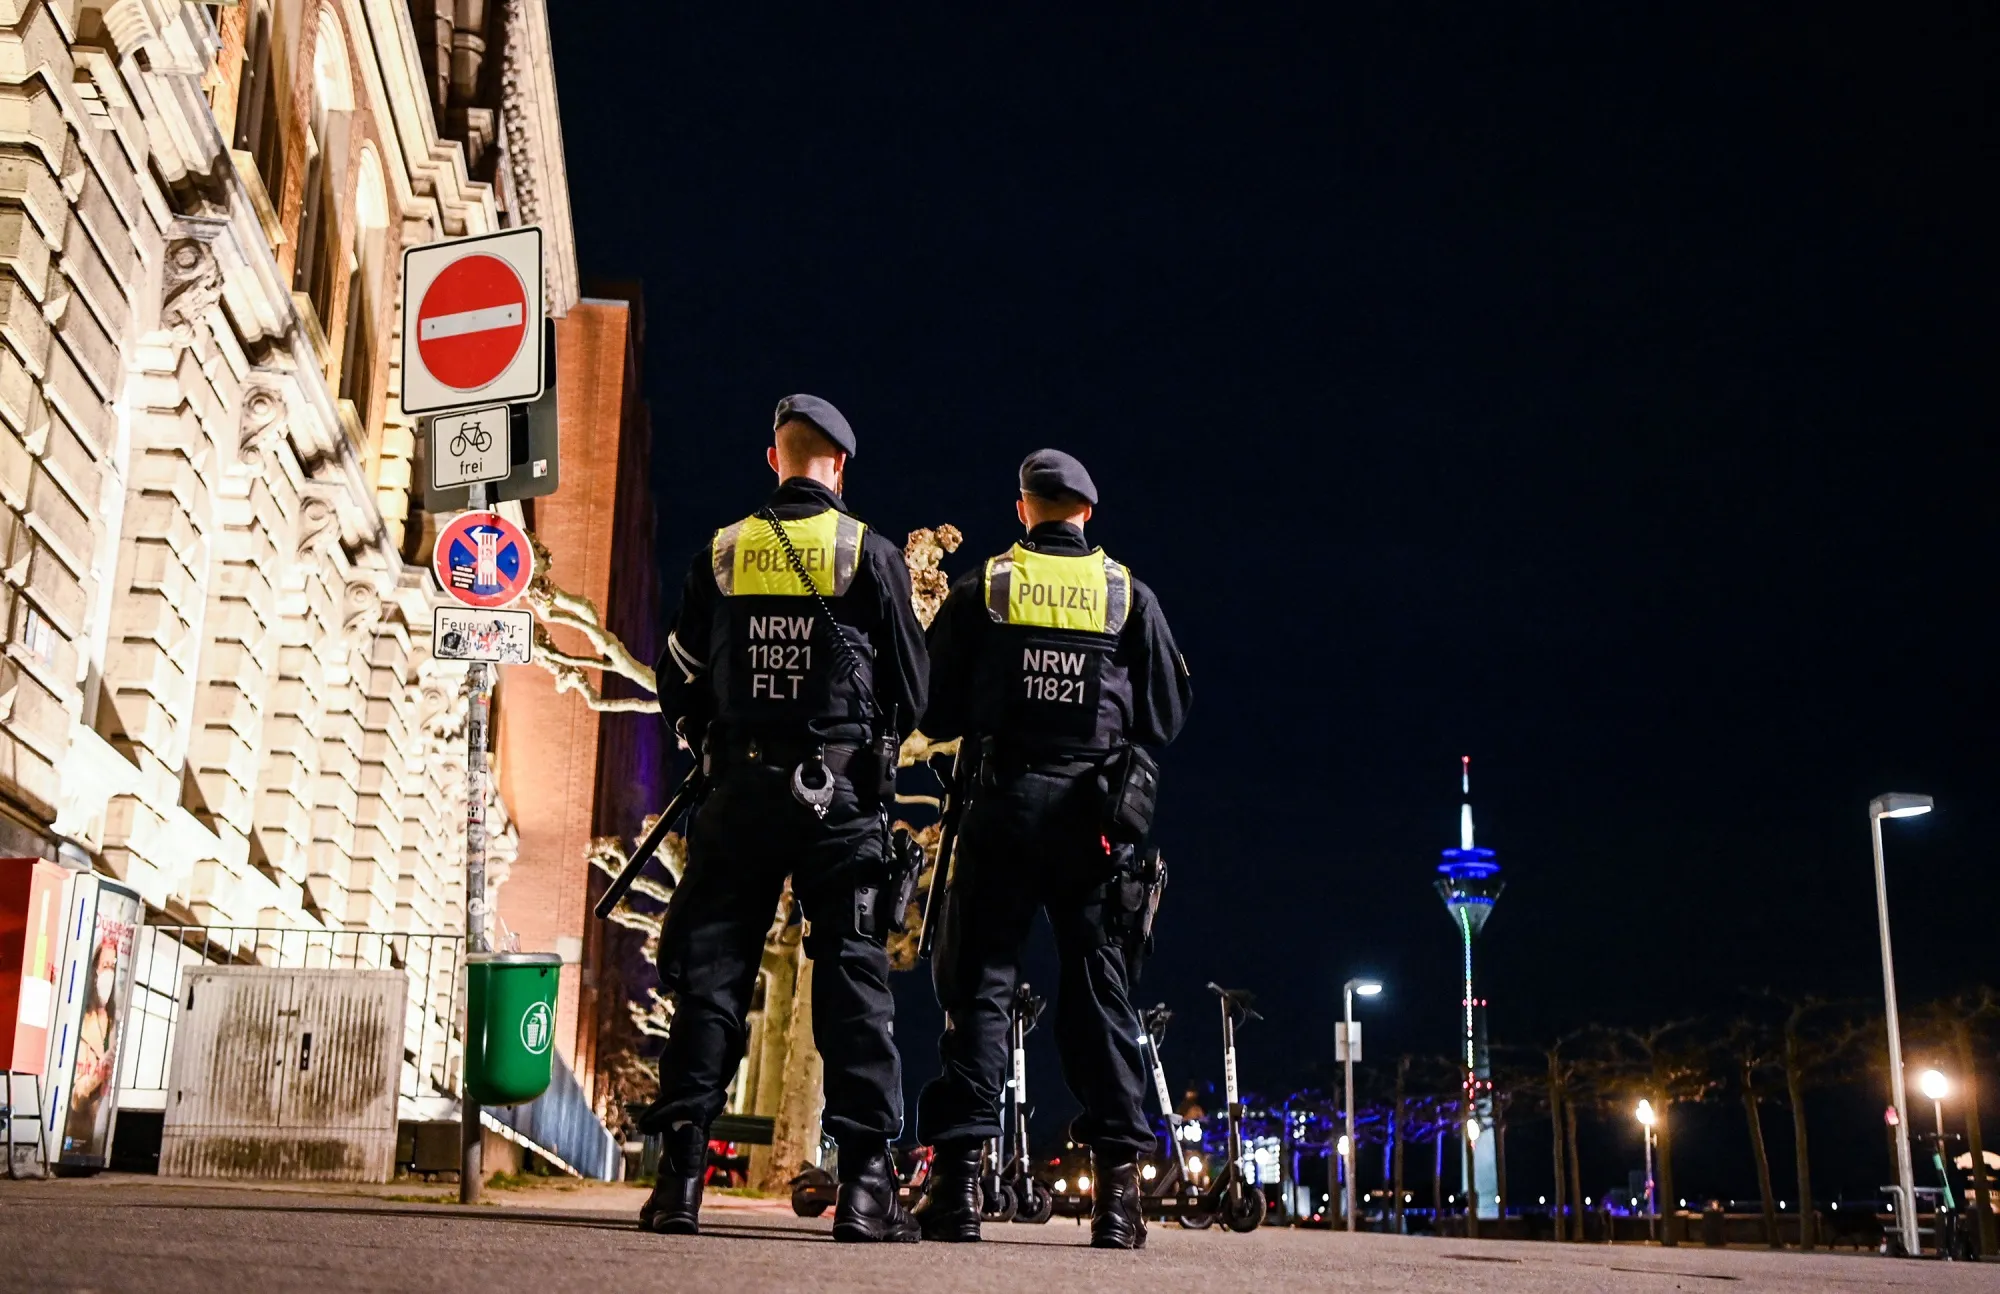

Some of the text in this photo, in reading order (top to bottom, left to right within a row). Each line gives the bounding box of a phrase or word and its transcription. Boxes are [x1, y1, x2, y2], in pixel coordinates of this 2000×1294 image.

[460, 457, 483, 475] frei
[1018, 582, 1098, 611] POLIZEI
[441, 617, 523, 634] Feuerwhr-
[749, 615, 815, 640] NRW
[747, 644, 812, 670] 11821
[1022, 647, 1086, 676] NRW
[752, 673, 804, 699] FLT
[1023, 675, 1085, 704] 11821
